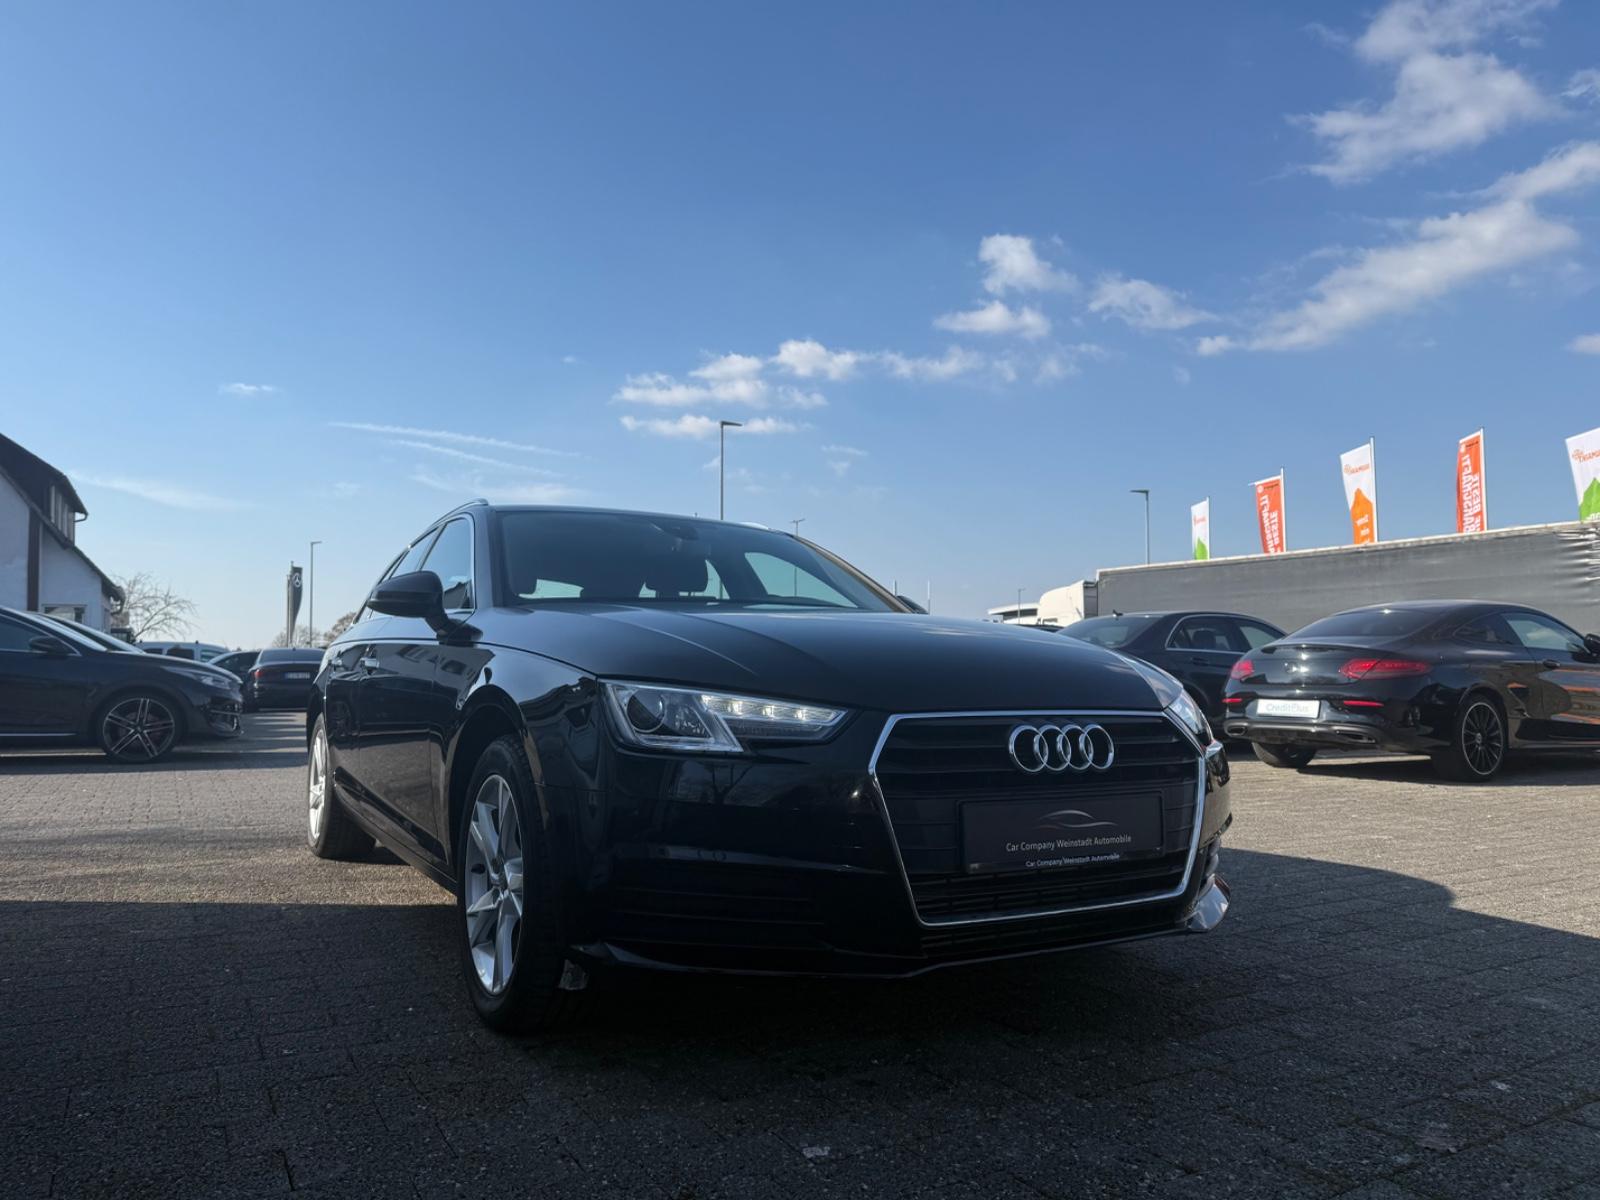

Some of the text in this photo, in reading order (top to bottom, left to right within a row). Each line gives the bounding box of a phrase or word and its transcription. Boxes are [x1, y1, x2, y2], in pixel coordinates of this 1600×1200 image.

[1006, 834, 1132, 852] Car Company Weinstadt Automobile
[1036, 859, 1063, 867] Company
[1062, 856, 1090, 864] Weinstadt
[1091, 853, 1120, 862] Automobile
